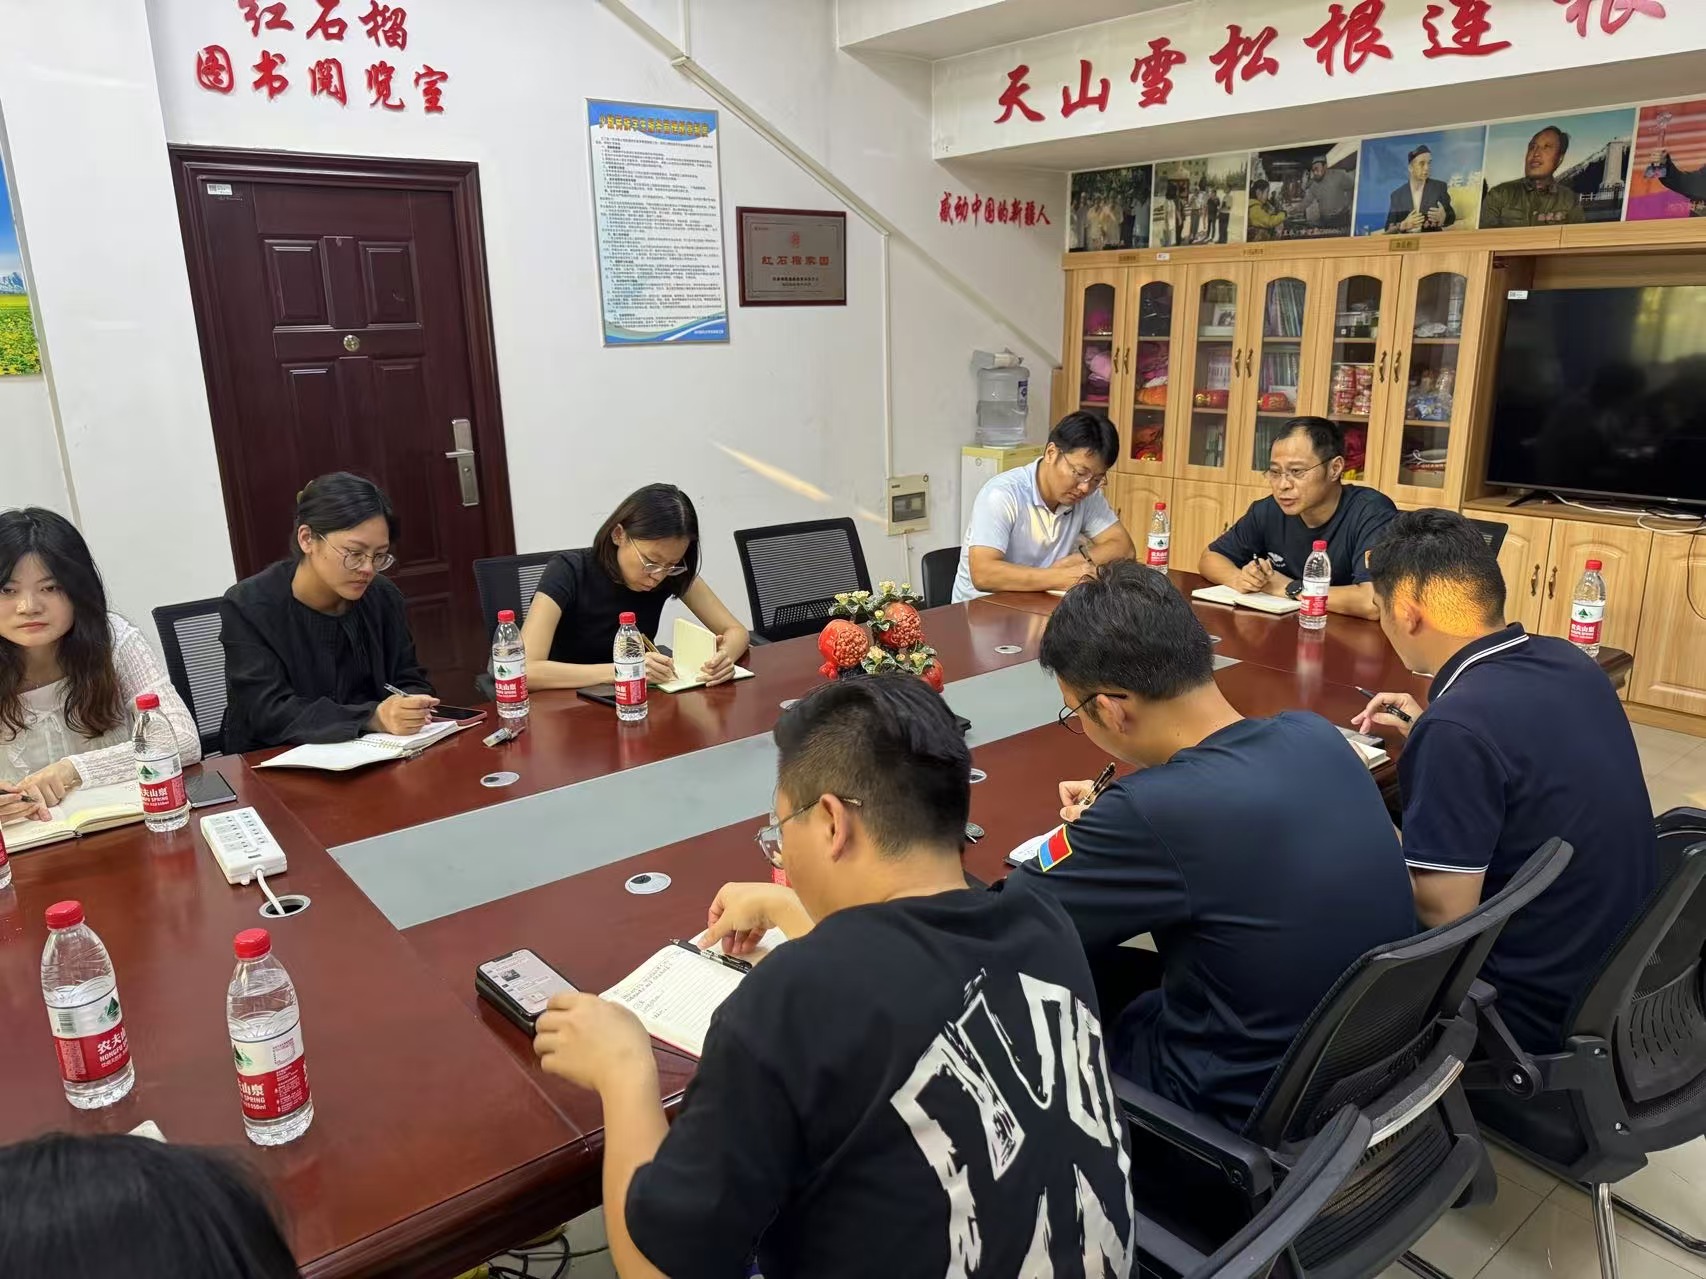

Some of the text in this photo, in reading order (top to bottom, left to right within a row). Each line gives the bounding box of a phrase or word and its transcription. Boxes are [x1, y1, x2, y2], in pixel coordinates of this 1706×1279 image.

[238, 0, 407, 50] 红石榴
[939, 191, 1051, 227] 感动中国的新疆人
[761, 255, 830, 266] 红石榴家园
[244, 1094, 265, 1103] SPRING
